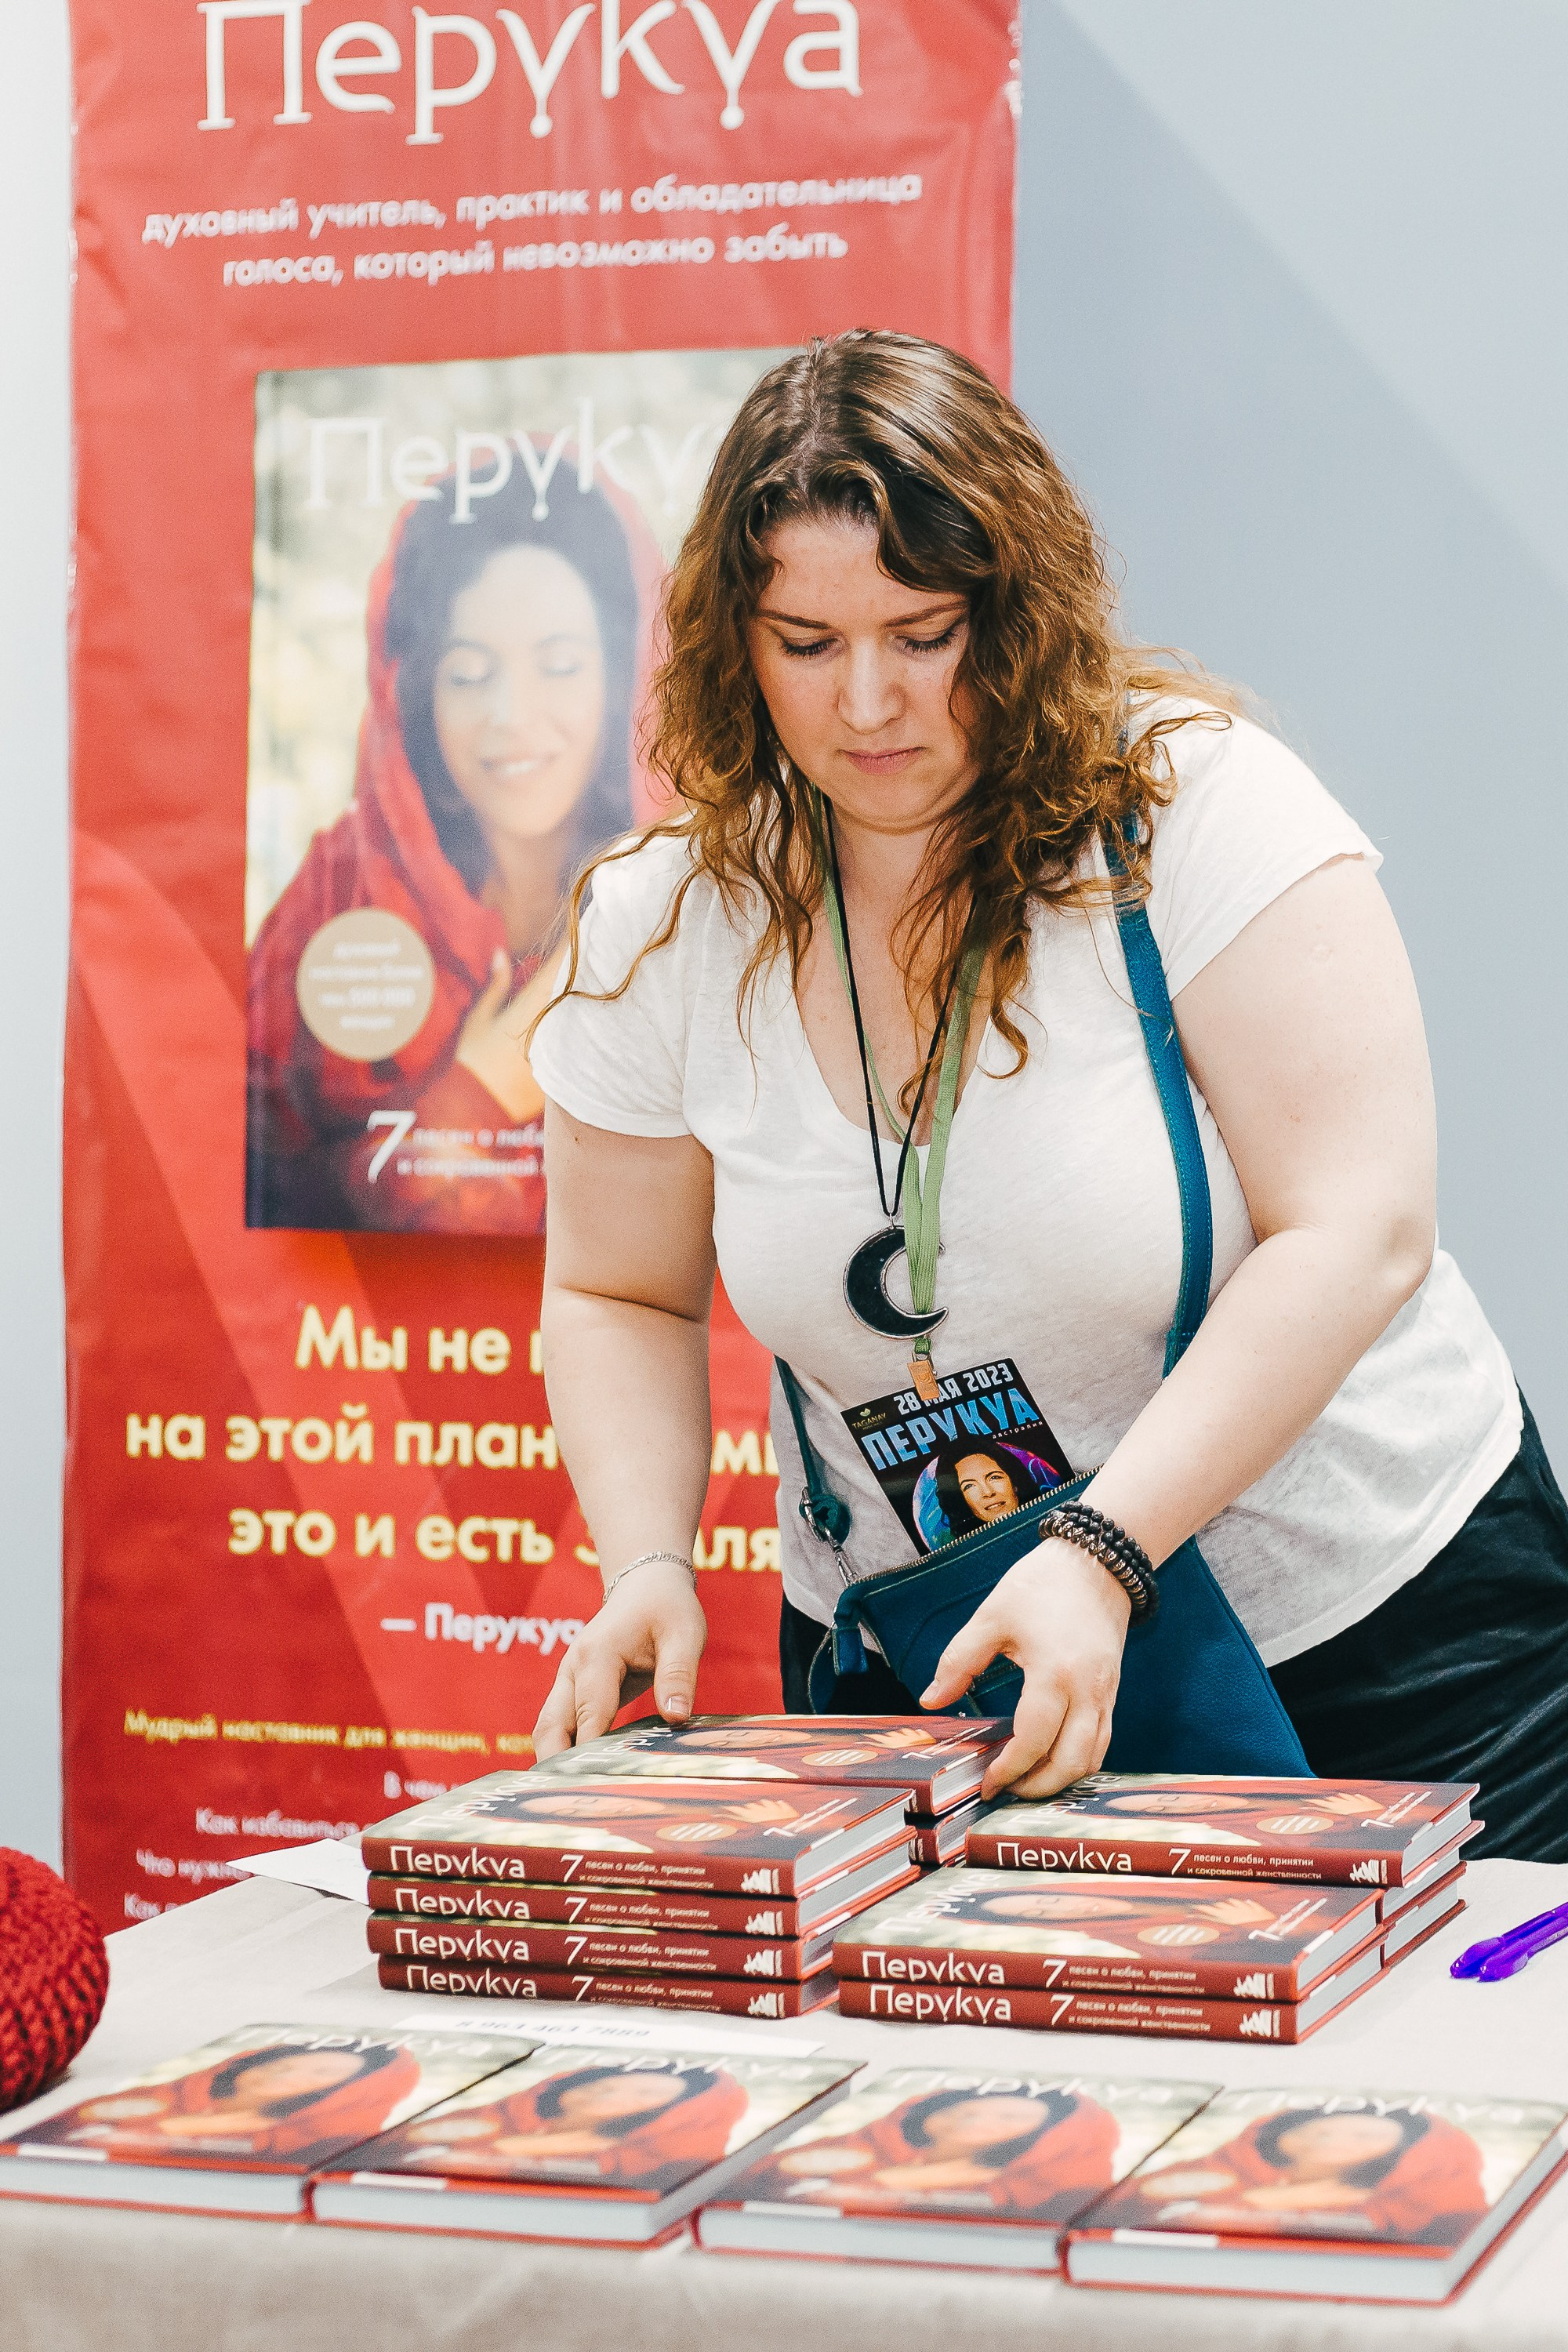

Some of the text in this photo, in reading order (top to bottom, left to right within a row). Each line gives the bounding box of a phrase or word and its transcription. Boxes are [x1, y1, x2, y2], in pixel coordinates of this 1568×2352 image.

[194, 0, 864, 146] Перукуа
[142, 173, 922, 249] духовный учитель, практик и обладательница
[223, 221, 848, 286] голоса, который невозможно забыть
[303, 396, 715, 524] Перуку
[367, 1109, 416, 1185] 7
[294, 1303, 408, 1371] Мы
[429, 1327, 511, 1376] не
[893, 1392, 921, 1415] 28
[964, 1363, 1014, 1393] 2023
[125, 1414, 205, 1461] на
[226, 1403, 373, 1465] этой
[395, 1420, 561, 1470] план
[861, 1387, 1040, 1471] ПЕРУКУА
[992, 1421, 1044, 1439] австралия
[228, 1508, 336, 1558] это
[356, 1512, 394, 1558] и
[417, 1514, 555, 1565] есть
[390, 1846, 706, 1882] Перукуа 7 песен о любви, принятии
[996, 1842, 1314, 1875] Перукуа 7 песен о любви, принятии
[395, 1887, 530, 1920] Перукуа
[564, 1896, 588, 1924] 7
[590, 1903, 618, 1914] песен
[629, 1901, 662, 1917] любви,
[665, 1907, 710, 1918] принятии
[394, 1928, 530, 1963] Перукуа
[564, 1936, 588, 1965] 7
[590, 1942, 618, 1953] песен
[628, 1940, 662, 1956] любви,
[665, 1946, 710, 1958] принятии
[862, 1951, 1005, 1985] Перукуа
[1043, 1959, 1067, 1988] 7
[1069, 1965, 1099, 1976] песен
[1102, 1967, 1108, 1976] о
[407, 1965, 537, 1998] Перукуа
[572, 1976, 594, 2002] 7
[870, 1984, 1012, 2024] Перукуа
[1051, 1994, 1075, 2026] 7
[1076, 2001, 1106, 2011] песен
[1108, 2002, 1116, 2012] о
